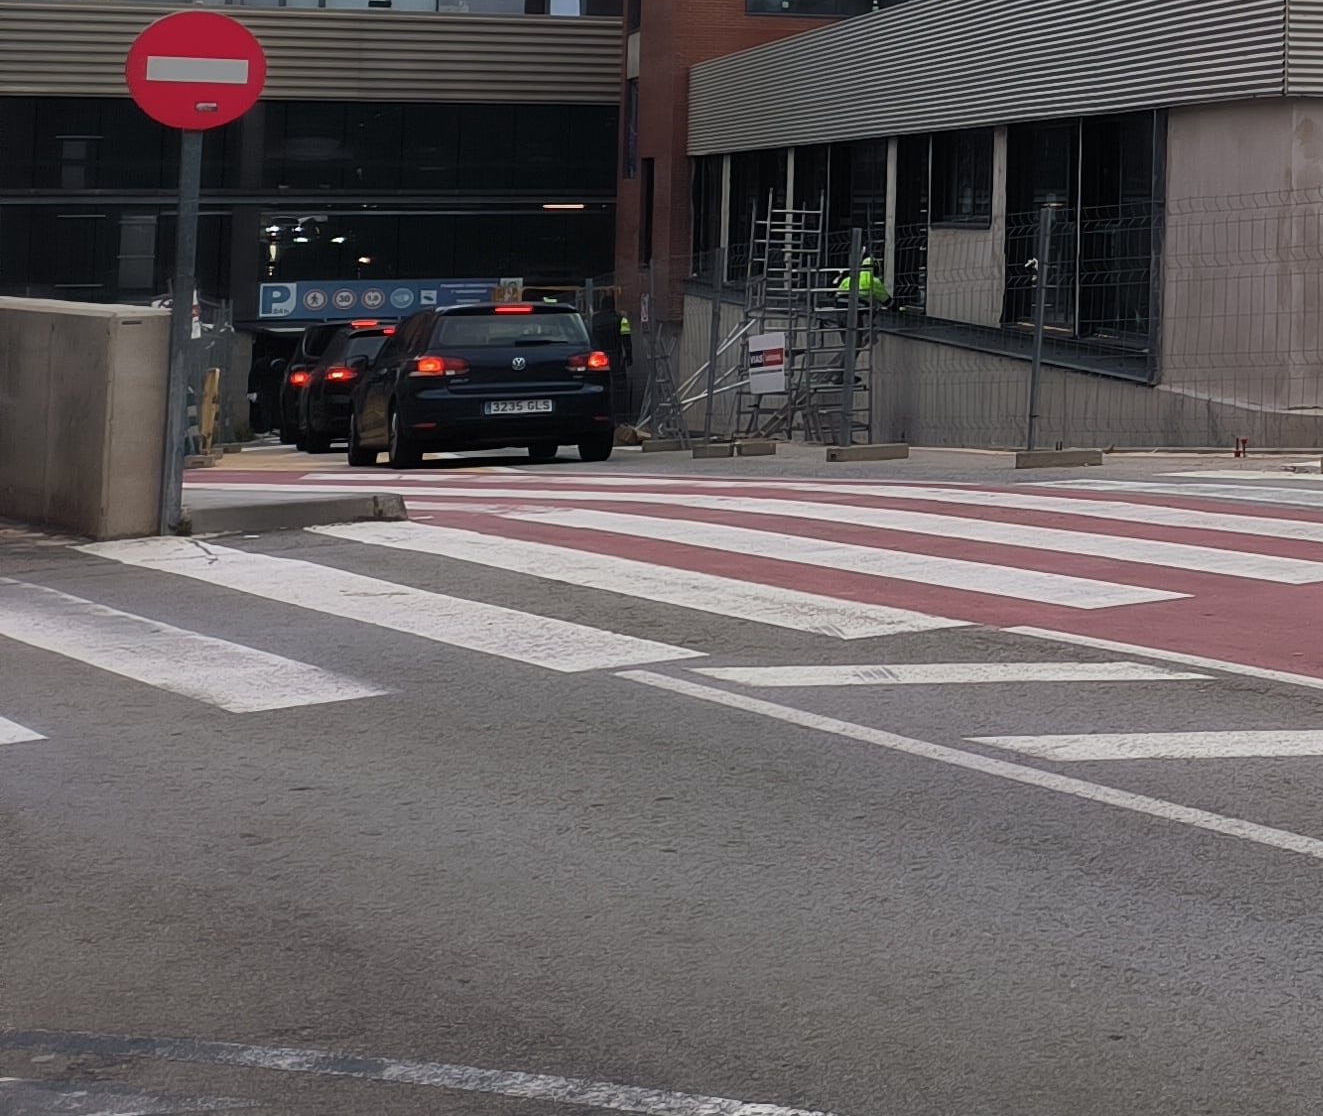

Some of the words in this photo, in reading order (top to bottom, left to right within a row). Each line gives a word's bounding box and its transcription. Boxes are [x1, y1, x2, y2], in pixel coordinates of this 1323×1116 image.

[262, 285, 291, 314] P
[492, 402, 523, 412] 3235
[527, 400, 550, 410] GLS
